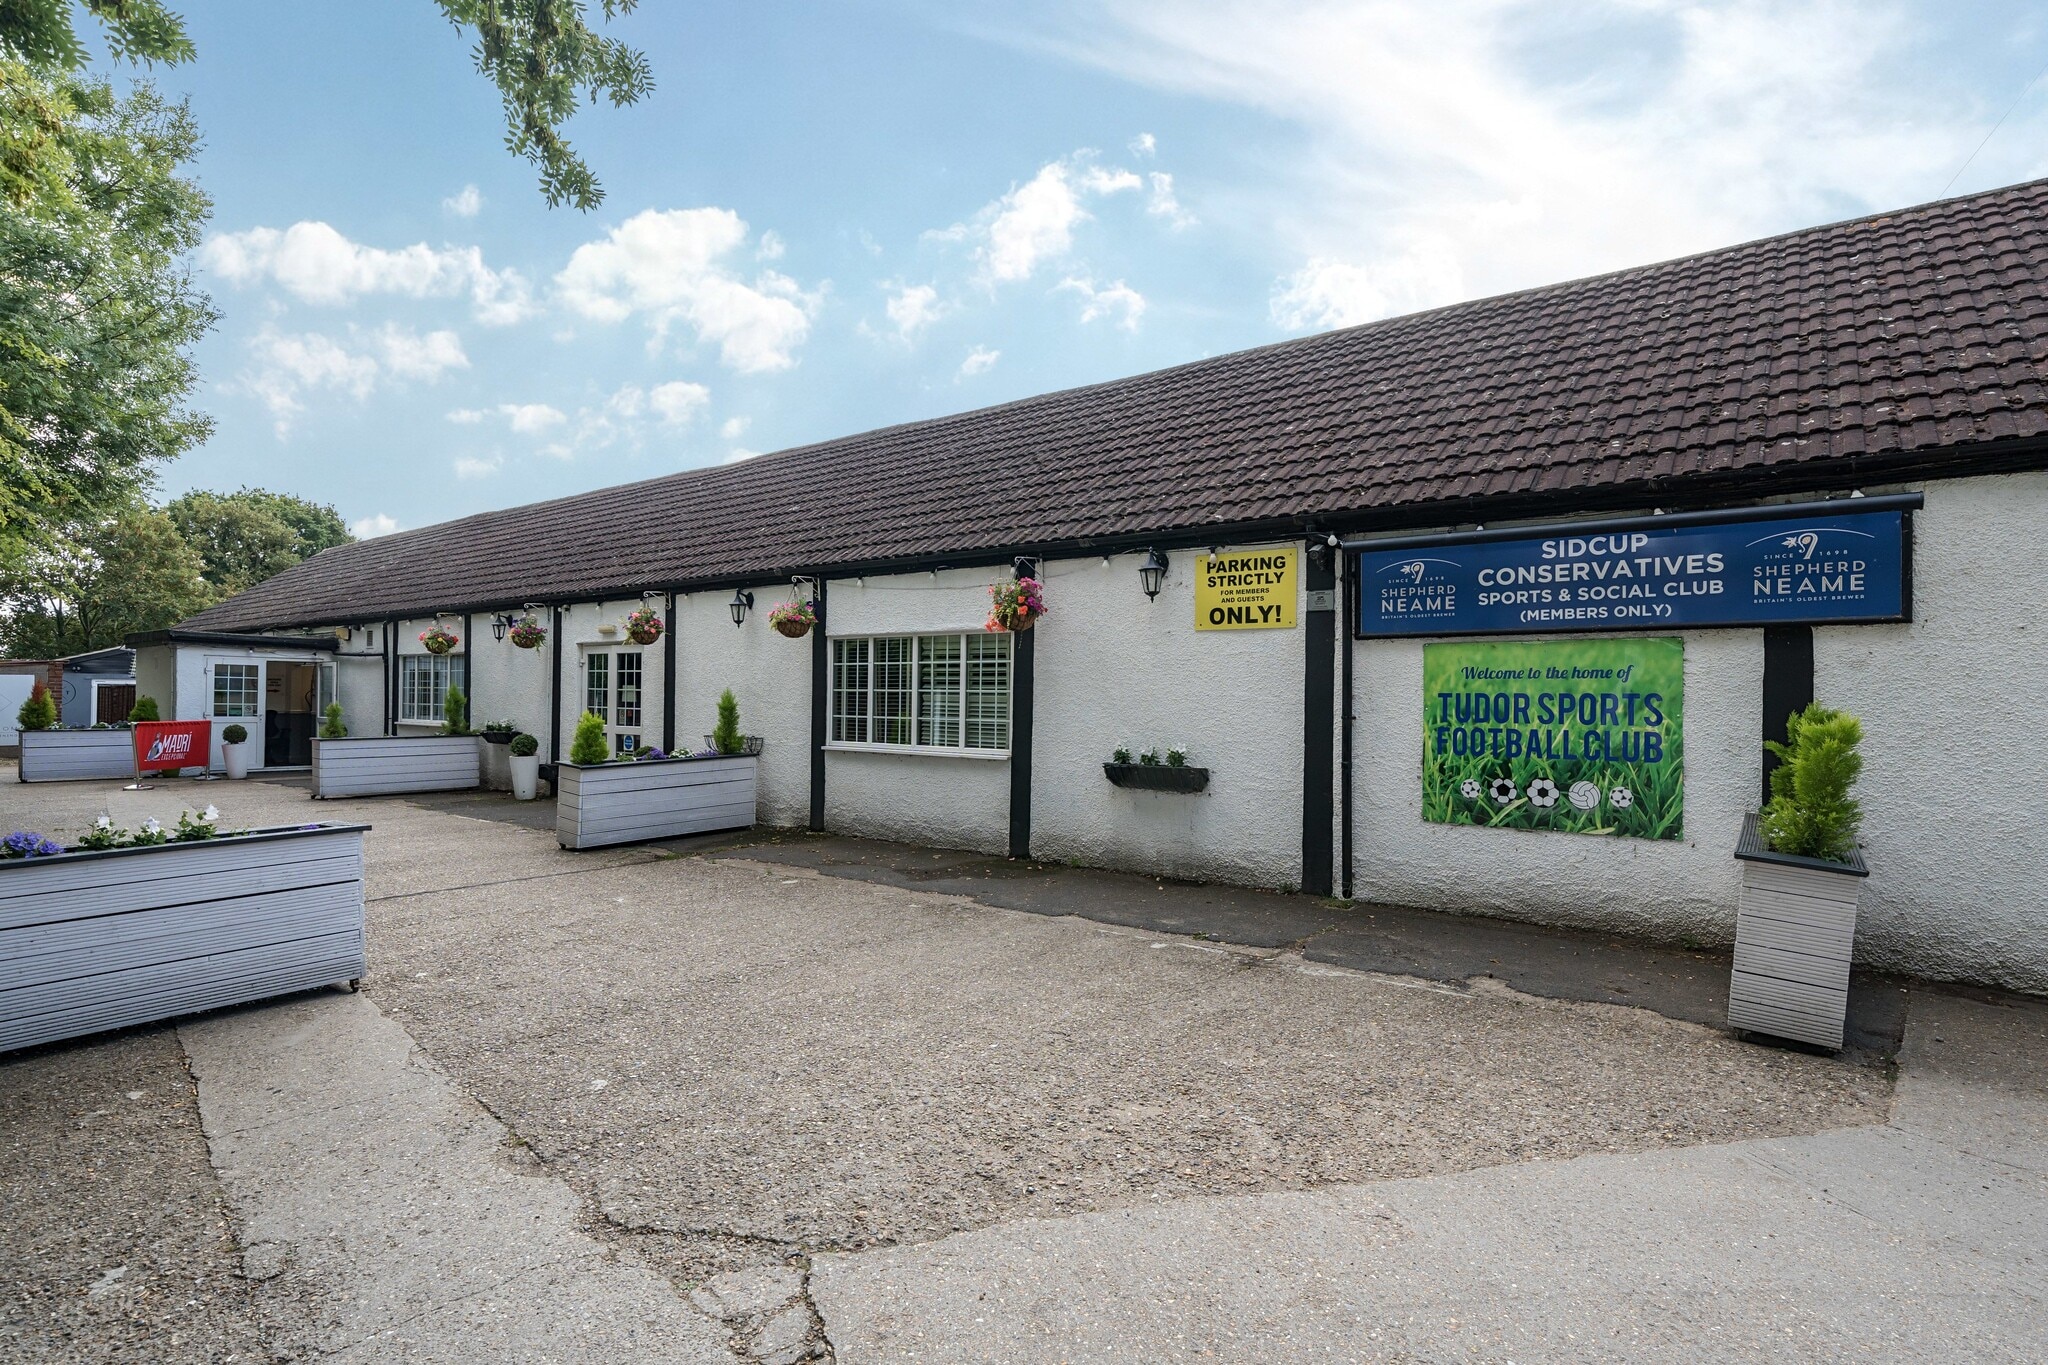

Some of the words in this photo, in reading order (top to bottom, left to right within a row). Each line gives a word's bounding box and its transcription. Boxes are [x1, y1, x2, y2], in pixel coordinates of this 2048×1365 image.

[1541, 534, 1649, 559] SIDCUP
[1206, 555, 1286, 574] PARKING
[1477, 552, 1725, 587] CONSERVATIVES
[1753, 560, 1866, 577] SHEPHERD
[1207, 571, 1285, 588] STRICTLY
[1753, 573, 1865, 596] NEAME
[1235, 587, 1270, 595] MEMBERS
[1237, 595, 1265, 603] GUESTS
[1381, 584, 1456, 598] SHEPHERD
[1478, 588, 1552, 606] SPORTS
[1558, 588, 1571, 602] &
[1577, 583, 1657, 601] SOCIAL
[1663, 579, 1724, 597] CLUB
[1381, 596, 1455, 613] NEAME
[1519, 606, 1609, 623] (MEMBERS
[1613, 603, 1672, 618] ONLY)
[1209, 604, 1281, 625] ONLY!
[1461, 666, 1525, 680] Welcome
[1527, 666, 1541, 679] to
[1545, 665, 1568, 680] the
[1570, 665, 1613, 680] home
[1616, 664, 1635, 683] of
[1437, 692, 1531, 725] TUDOR
[1537, 692, 1663, 727] SPORTS
[1437, 726, 1578, 761] FOOTBALL
[1583, 729, 1664, 763] CLUB
